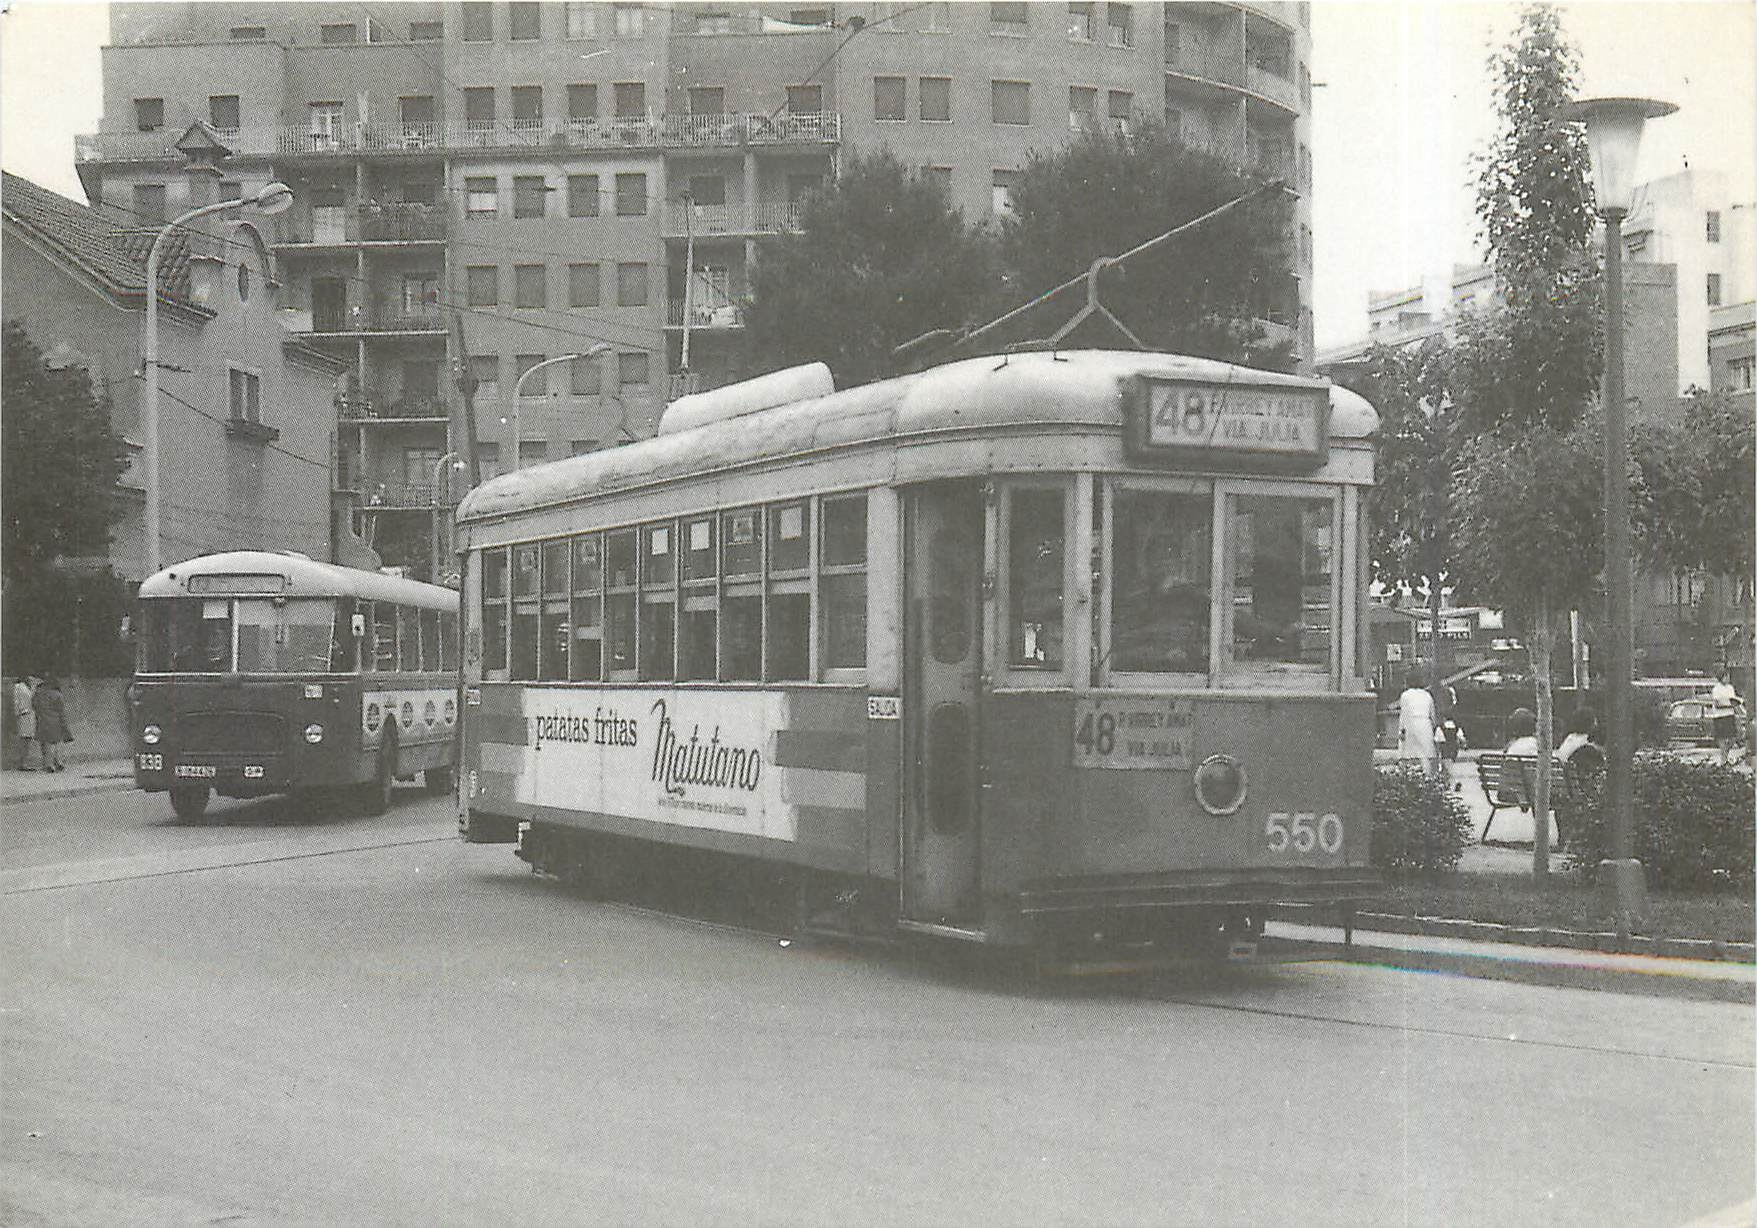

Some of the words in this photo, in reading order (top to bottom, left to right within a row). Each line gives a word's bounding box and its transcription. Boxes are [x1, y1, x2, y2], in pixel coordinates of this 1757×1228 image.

[1155, 389, 1205, 436] 48
[1223, 419, 1248, 438] VIA
[536, 709, 589, 750] patatas
[594, 708, 637, 747] fritas
[651, 698, 761, 796] Matutano
[1076, 712, 1115, 756] 48
[1266, 812, 1343, 852] 550
